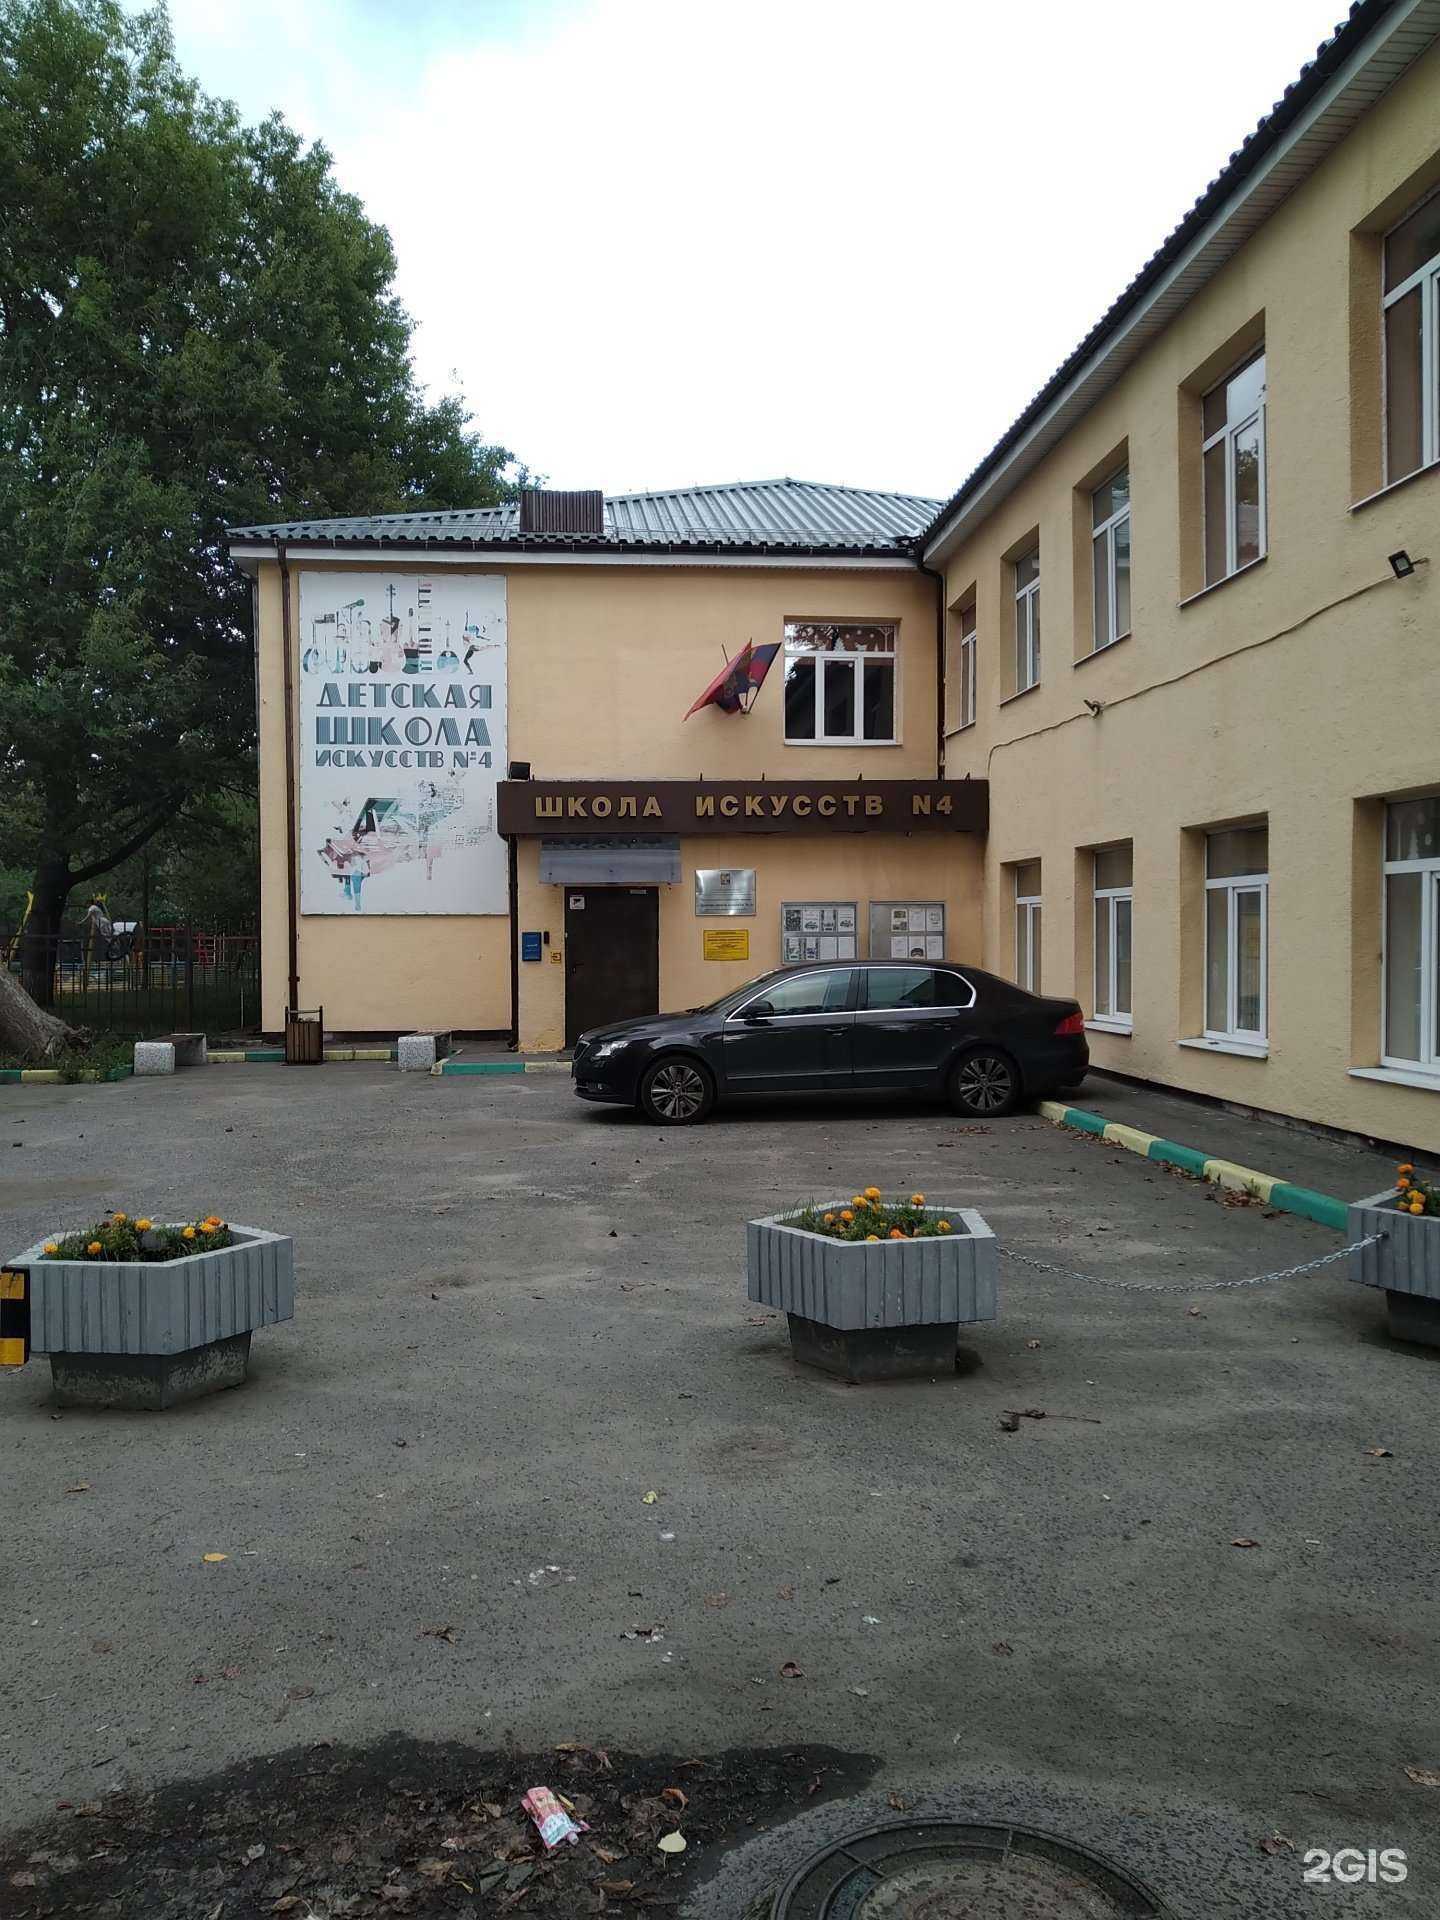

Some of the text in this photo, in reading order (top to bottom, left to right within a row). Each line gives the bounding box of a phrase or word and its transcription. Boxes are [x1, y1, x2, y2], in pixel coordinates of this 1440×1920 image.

[316, 683, 492, 709] ДЕТСКАЯ
[316, 716, 491, 746] ШКОЛА
[315, 749, 444, 768] ИСКУССТВ
[535, 794, 953, 818] ШКОЛА ИСКУССТВ N4
